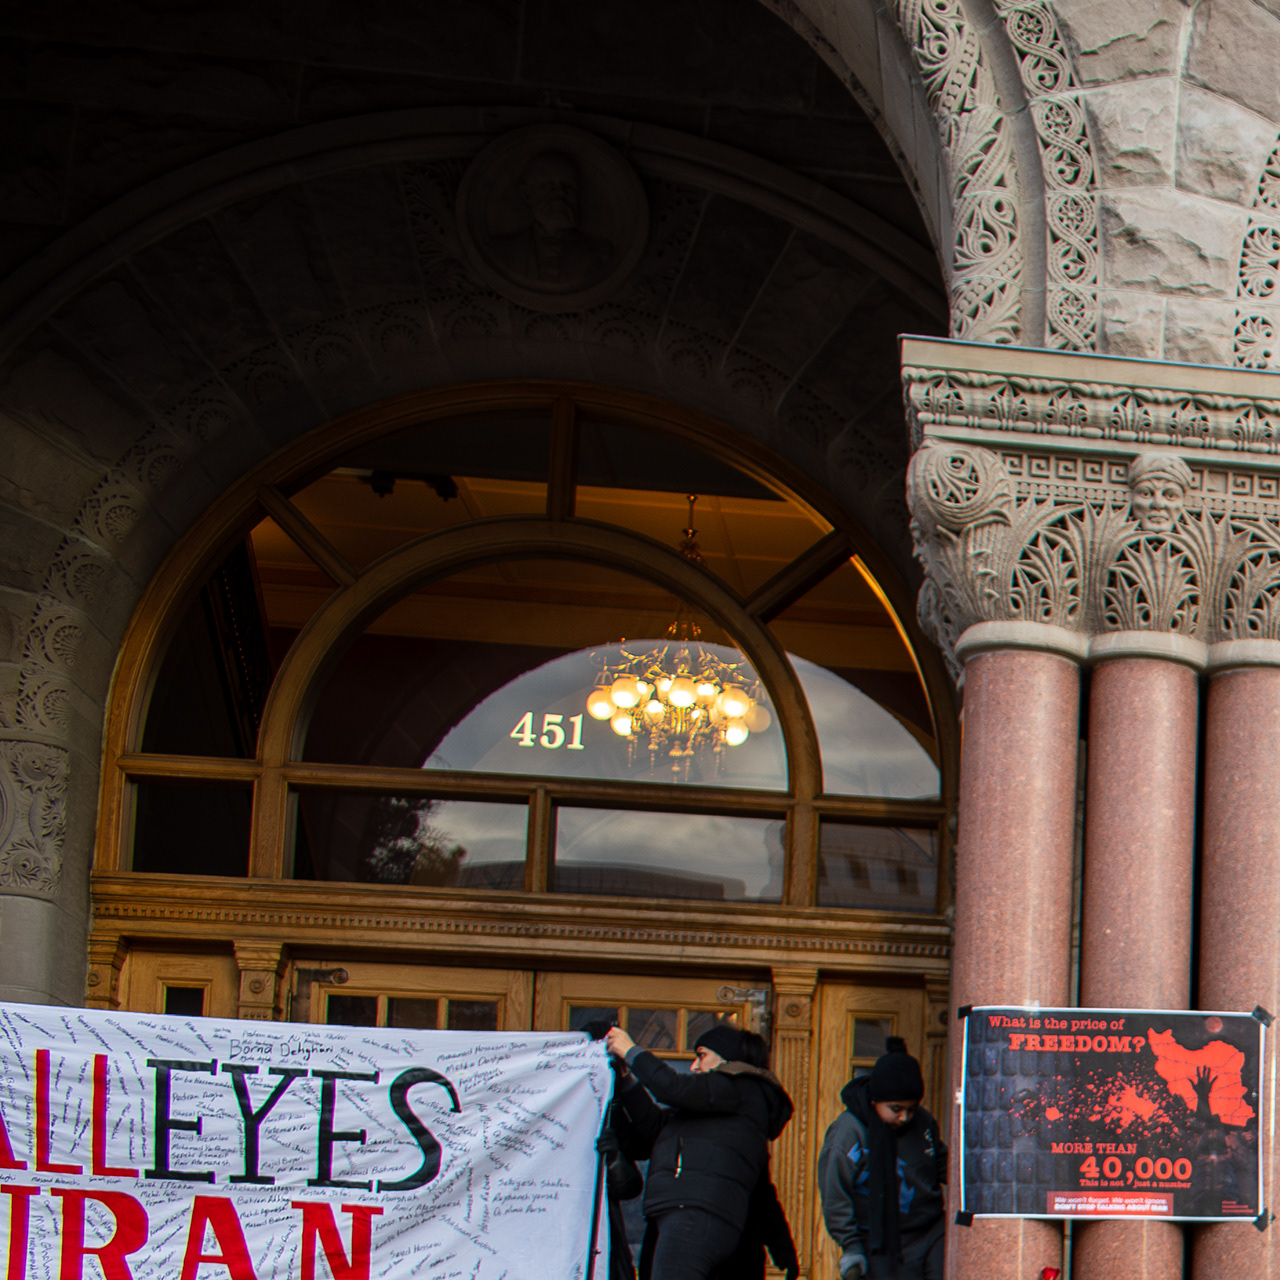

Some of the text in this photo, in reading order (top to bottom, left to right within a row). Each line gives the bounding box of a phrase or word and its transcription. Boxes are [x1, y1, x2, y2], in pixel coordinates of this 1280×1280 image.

[510, 712, 585, 750] 451
[989, 1015, 1126, 1032] What is the price of
[1008, 1033, 1146, 1053] FREEDOM?
[145, 1057, 462, 1194] EYES
[1051, 1142, 1138, 1155] MORE THAN
[1079, 1156, 1193, 1185] 40,000
[1079, 1179, 1100, 1187] This
[1134, 1180, 1151, 1189] just
[1159, 1181, 1192, 1189] number
